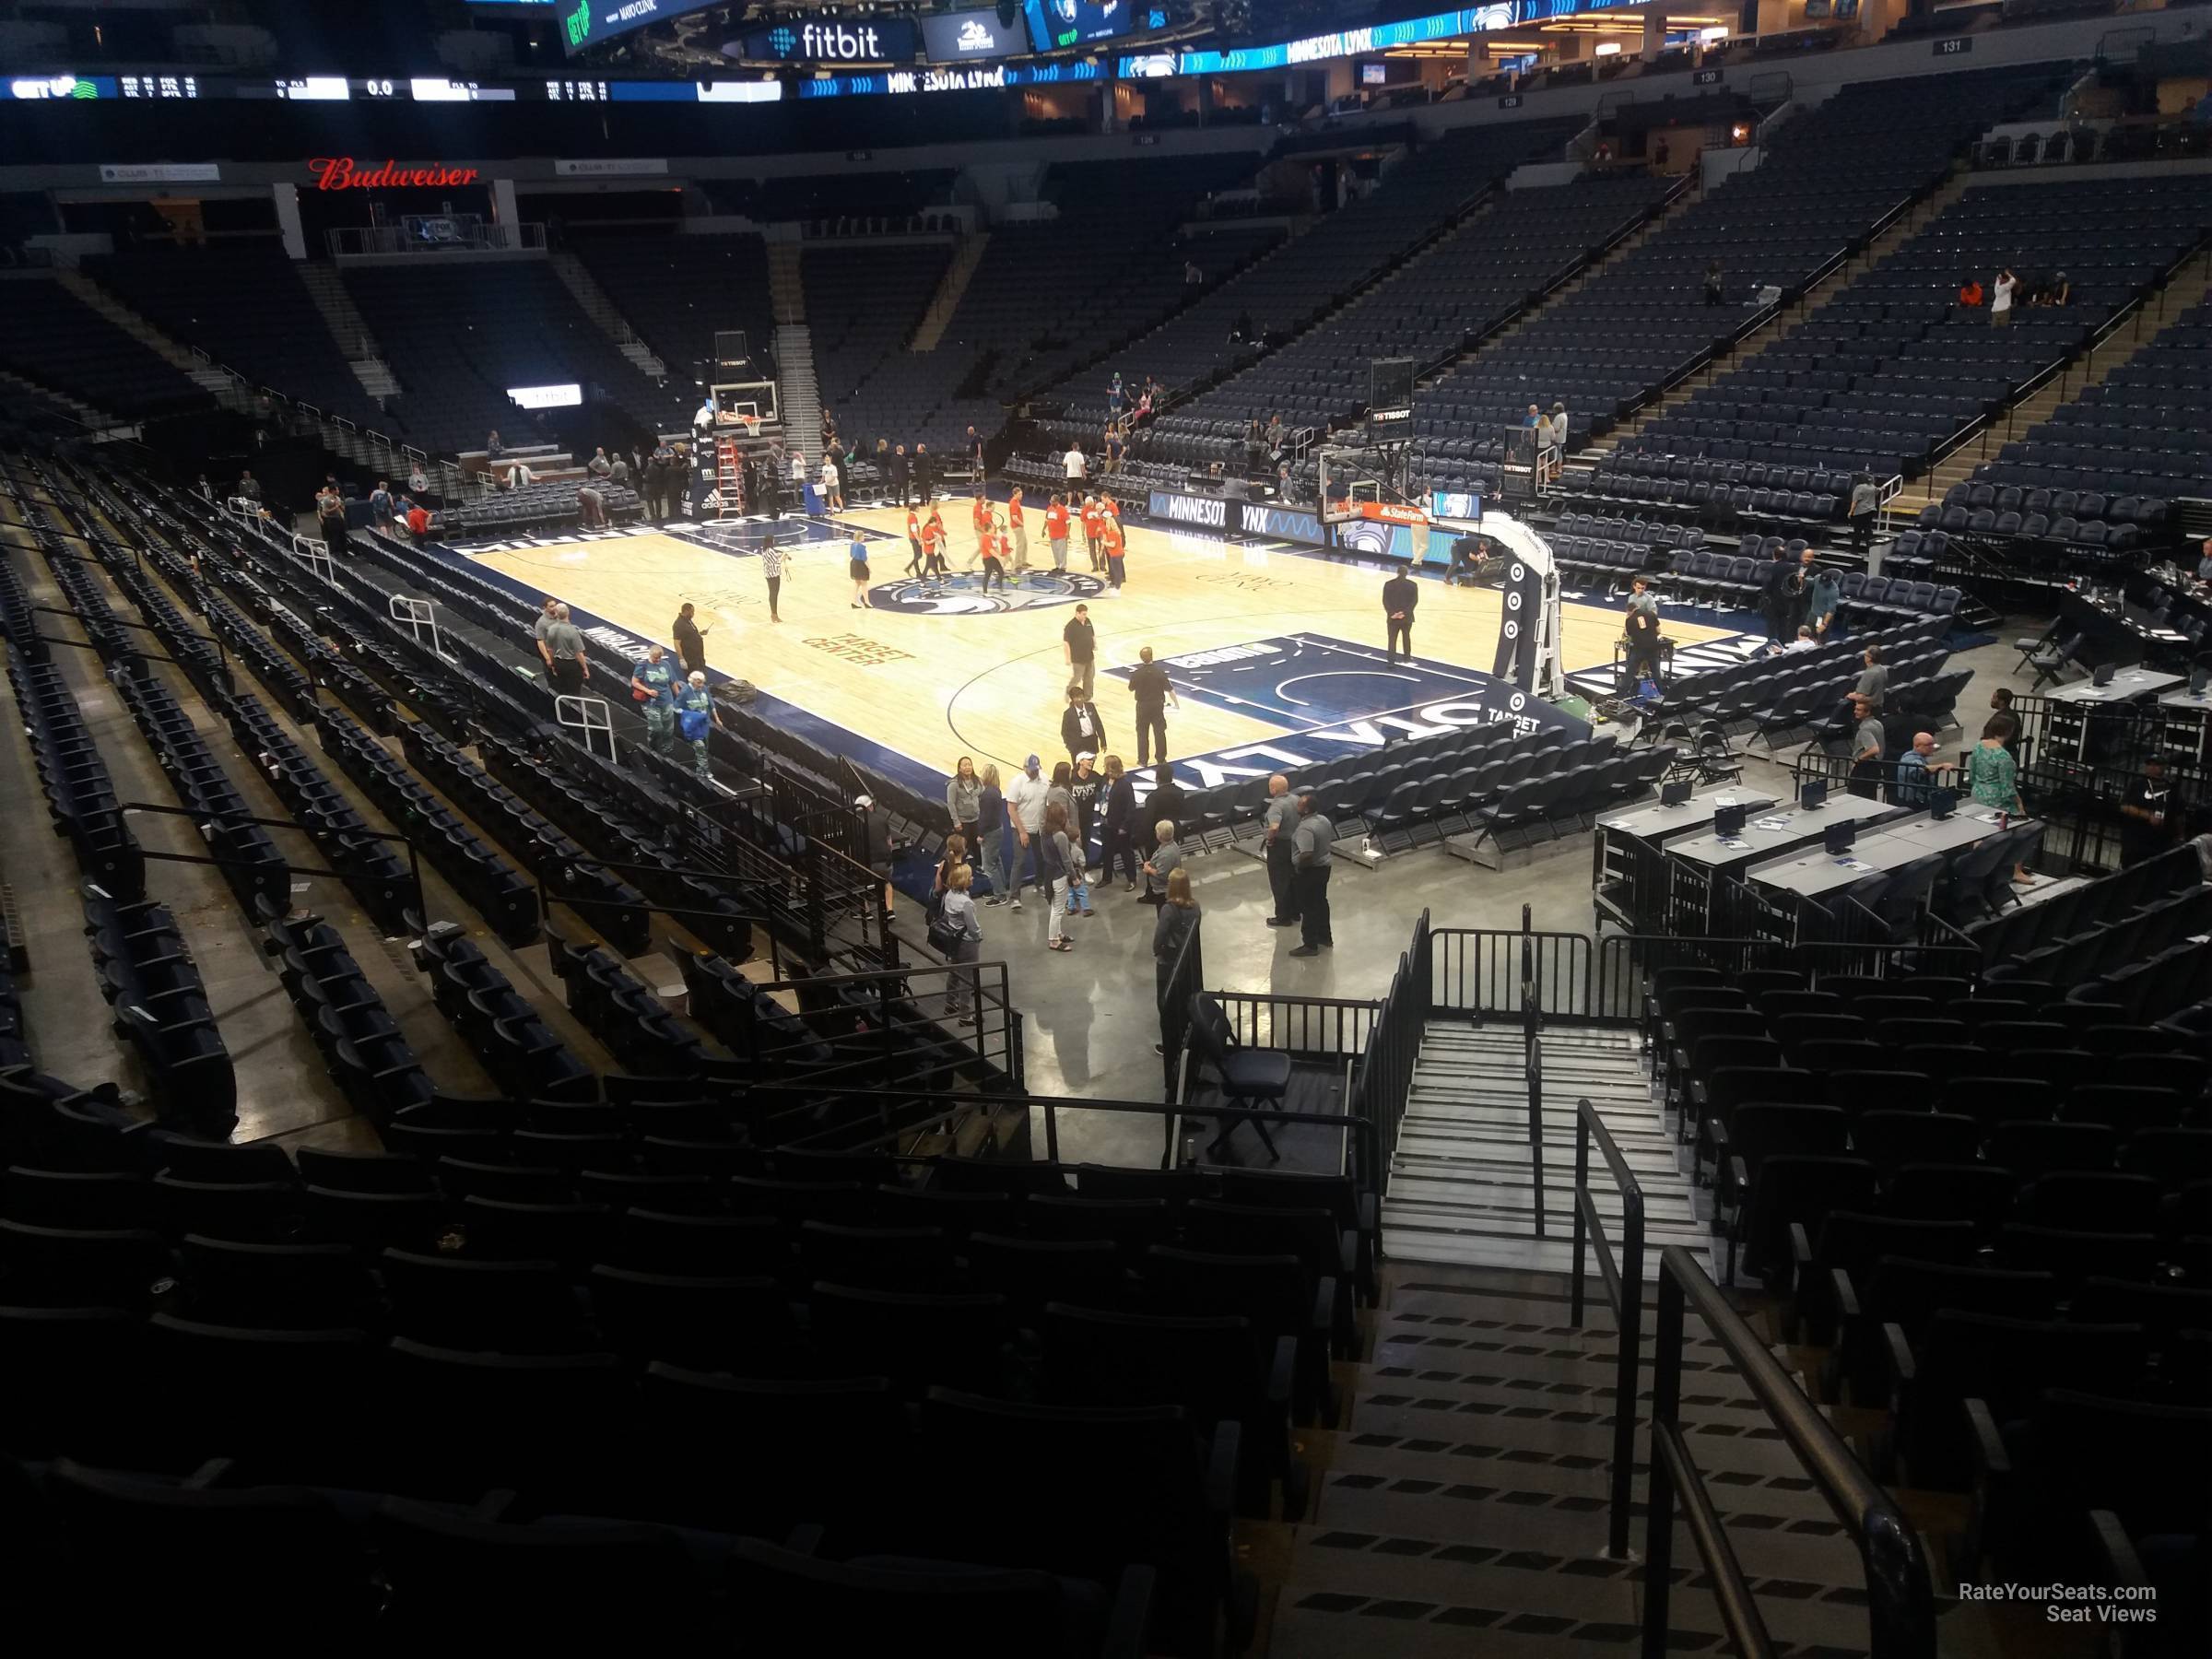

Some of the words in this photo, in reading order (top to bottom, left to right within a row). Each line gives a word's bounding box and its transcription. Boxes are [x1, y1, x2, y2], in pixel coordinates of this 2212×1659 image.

[803, 24, 879, 59] fitbit
[1287, 34, 1343, 64] MINNESOTA
[1345, 28, 1372, 55] LYNX
[1942, 40, 1960, 52] 131
[368, 80, 393, 96] 0.0
[1701, 72, 1716, 82] 130
[309, 157, 478, 191] Budweiser
[1384, 409, 1410, 419] TISSOT
[1512, 465, 1532, 474] TISSOT
[701, 500, 729, 509] adidas
[1241, 505, 1268, 533] YNX
[801, 638, 886, 666] CENTER
[831, 632, 917, 662] TARGET
